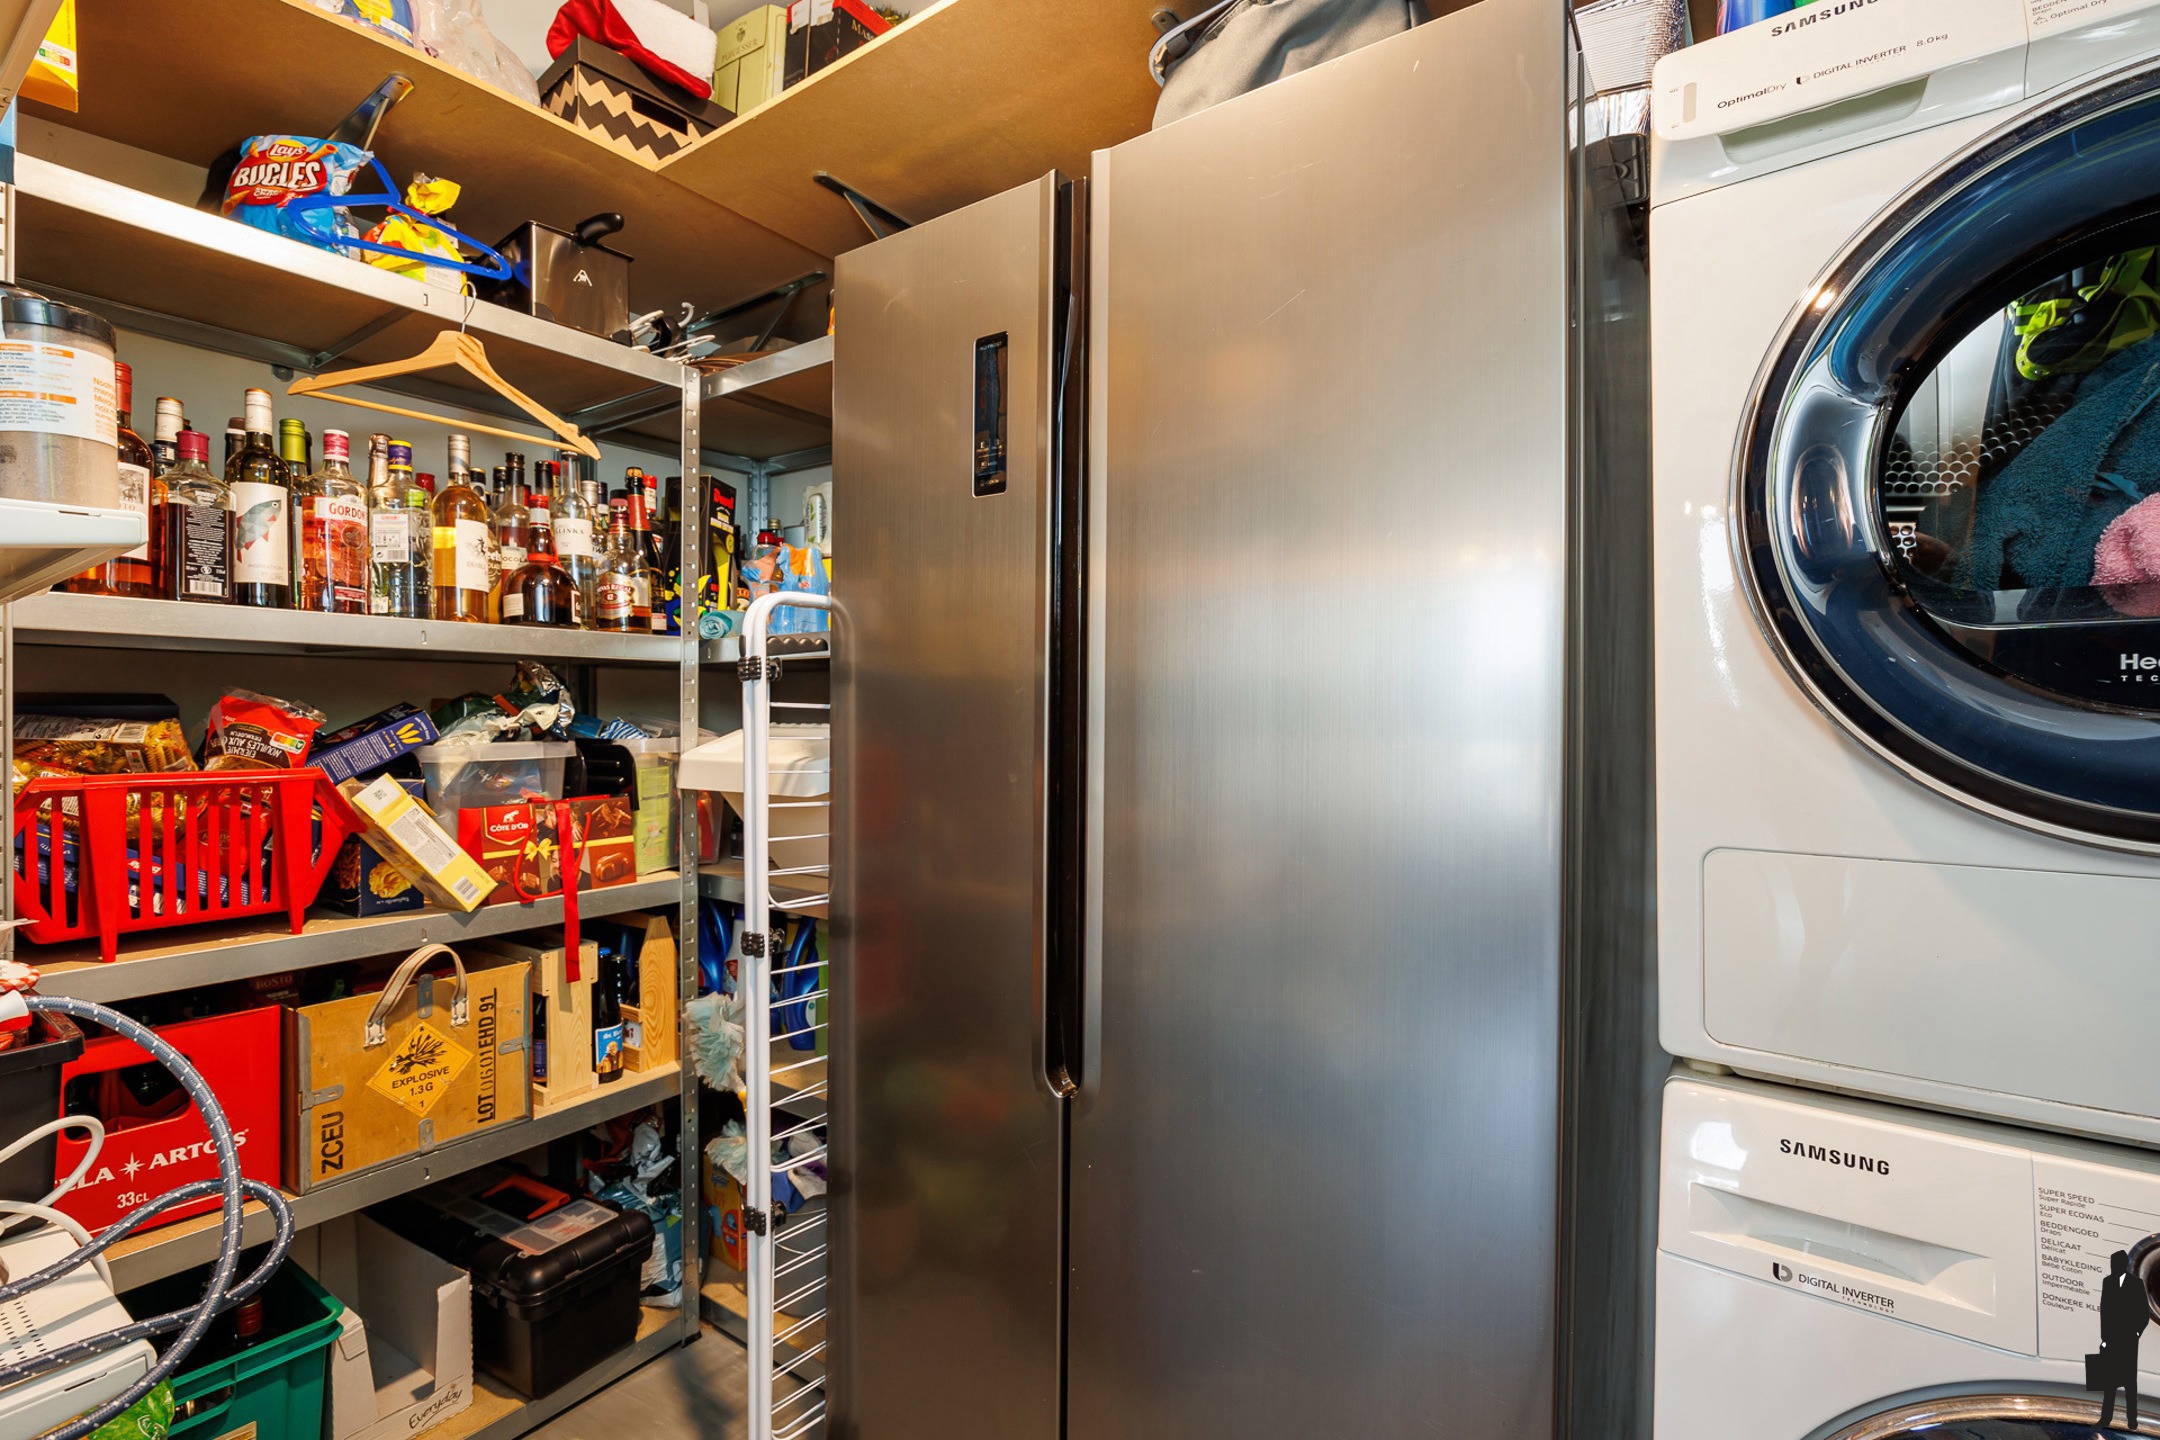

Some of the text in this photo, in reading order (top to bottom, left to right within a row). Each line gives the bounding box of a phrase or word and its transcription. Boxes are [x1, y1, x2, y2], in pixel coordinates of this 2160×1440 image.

[1771, 0, 1880, 37] SAMSUN
[2050, 4, 2088, 19] Optimal
[1813, 62, 1853, 80] DIGITAL
[1855, 45, 1907, 66] INVERTER
[1717, 82, 1787, 109] OptimalDry
[233, 161, 321, 189] BUGLES
[2121, 653, 2160, 670] He
[228, 736, 247, 746] AUX
[246, 740, 283, 758] NOUILLES
[392, 1066, 450, 1089] EXPLOSIVE
[477, 1094, 494, 1123] LOT
[148, 1131, 247, 1170] ARTOS
[321, 1111, 344, 1175] ZCEU
[1780, 1138, 1890, 1176] SAMSUNG
[117, 1191, 150, 1209] 33CL
[2038, 1187, 2095, 1204] SUPER SPEED
[2039, 1194, 2059, 1203] Super
[2039, 1204, 2105, 1223] SUPER ECOWAS
[2040, 1220, 2099, 1238] BEDDENGOED
[2041, 1227, 2062, 1236] Draps
[2041, 1237, 2082, 1251] DELICAAT
[2041, 1254, 2102, 1273] BABYKLEDING
[2061, 1265, 2083, 1274] Coton
[2042, 1272, 2084, 1287] OUTDOOR
[2042, 1279, 2091, 1295] Imperméable
[1798, 1273, 1895, 1309] DIGITAL INVERTER
[2042, 1292, 2084, 1307] DONKERE
[2042, 1299, 2075, 1312] Couleurs
[409, 1389, 463, 1429] Everyday
